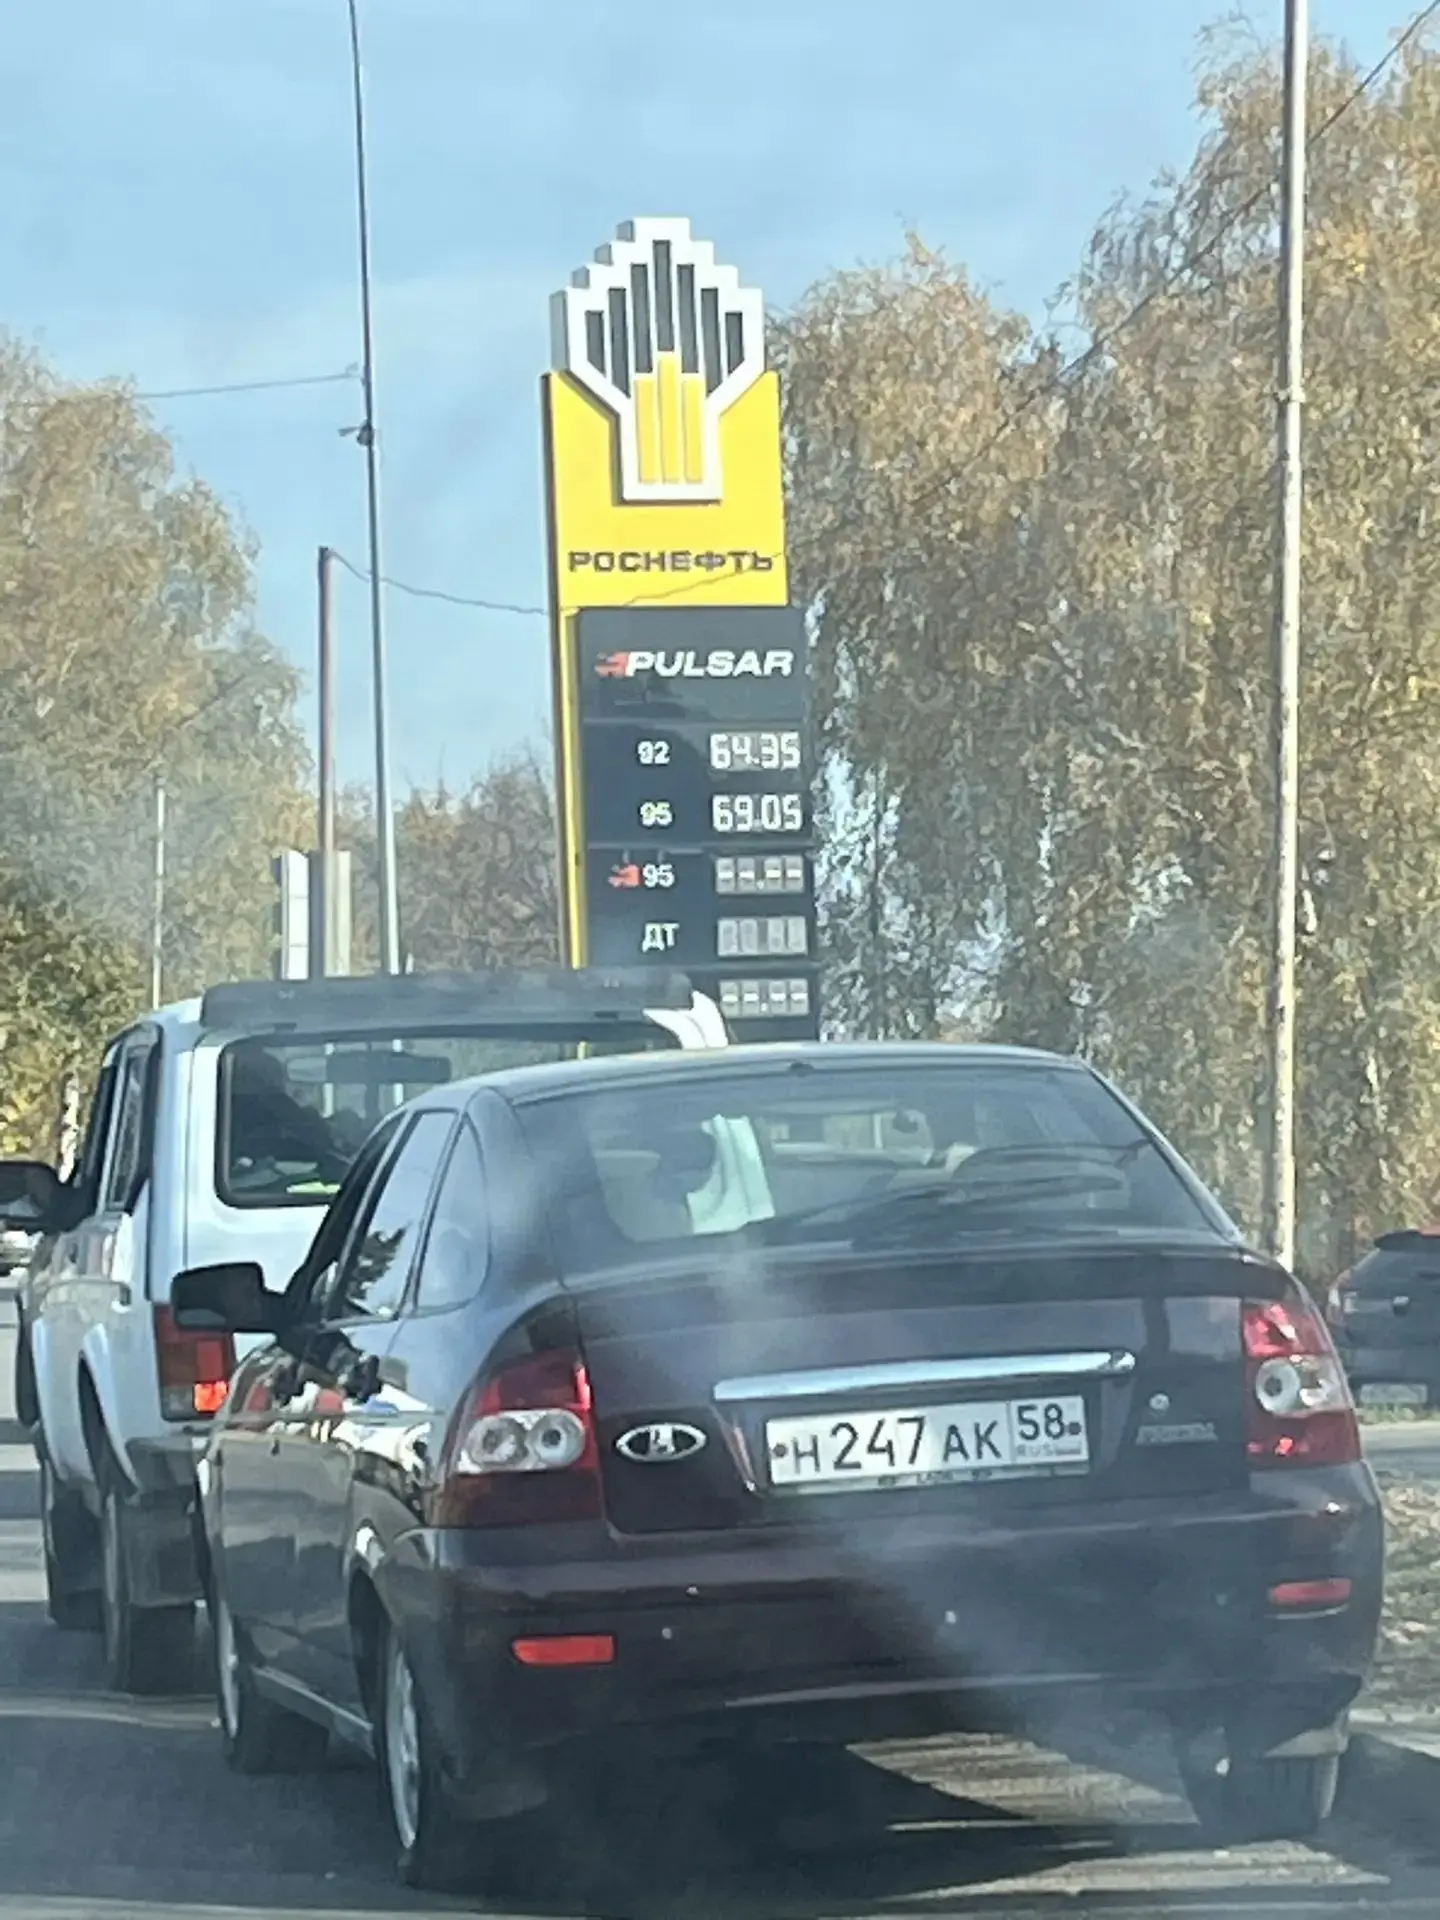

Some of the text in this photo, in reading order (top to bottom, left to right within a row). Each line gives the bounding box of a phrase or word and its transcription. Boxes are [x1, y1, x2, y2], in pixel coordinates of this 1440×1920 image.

[568, 550, 773, 573] РОСНЕФТЬ
[625, 650, 794, 677] PULSAR
[637, 731, 801, 770] 92 64.35
[640, 794, 802, 832] 95 69.05
[643, 864, 675, 888] 95
[642, 922, 680, 952] ДТ
[1017, 1403, 1065, 1441] 58
